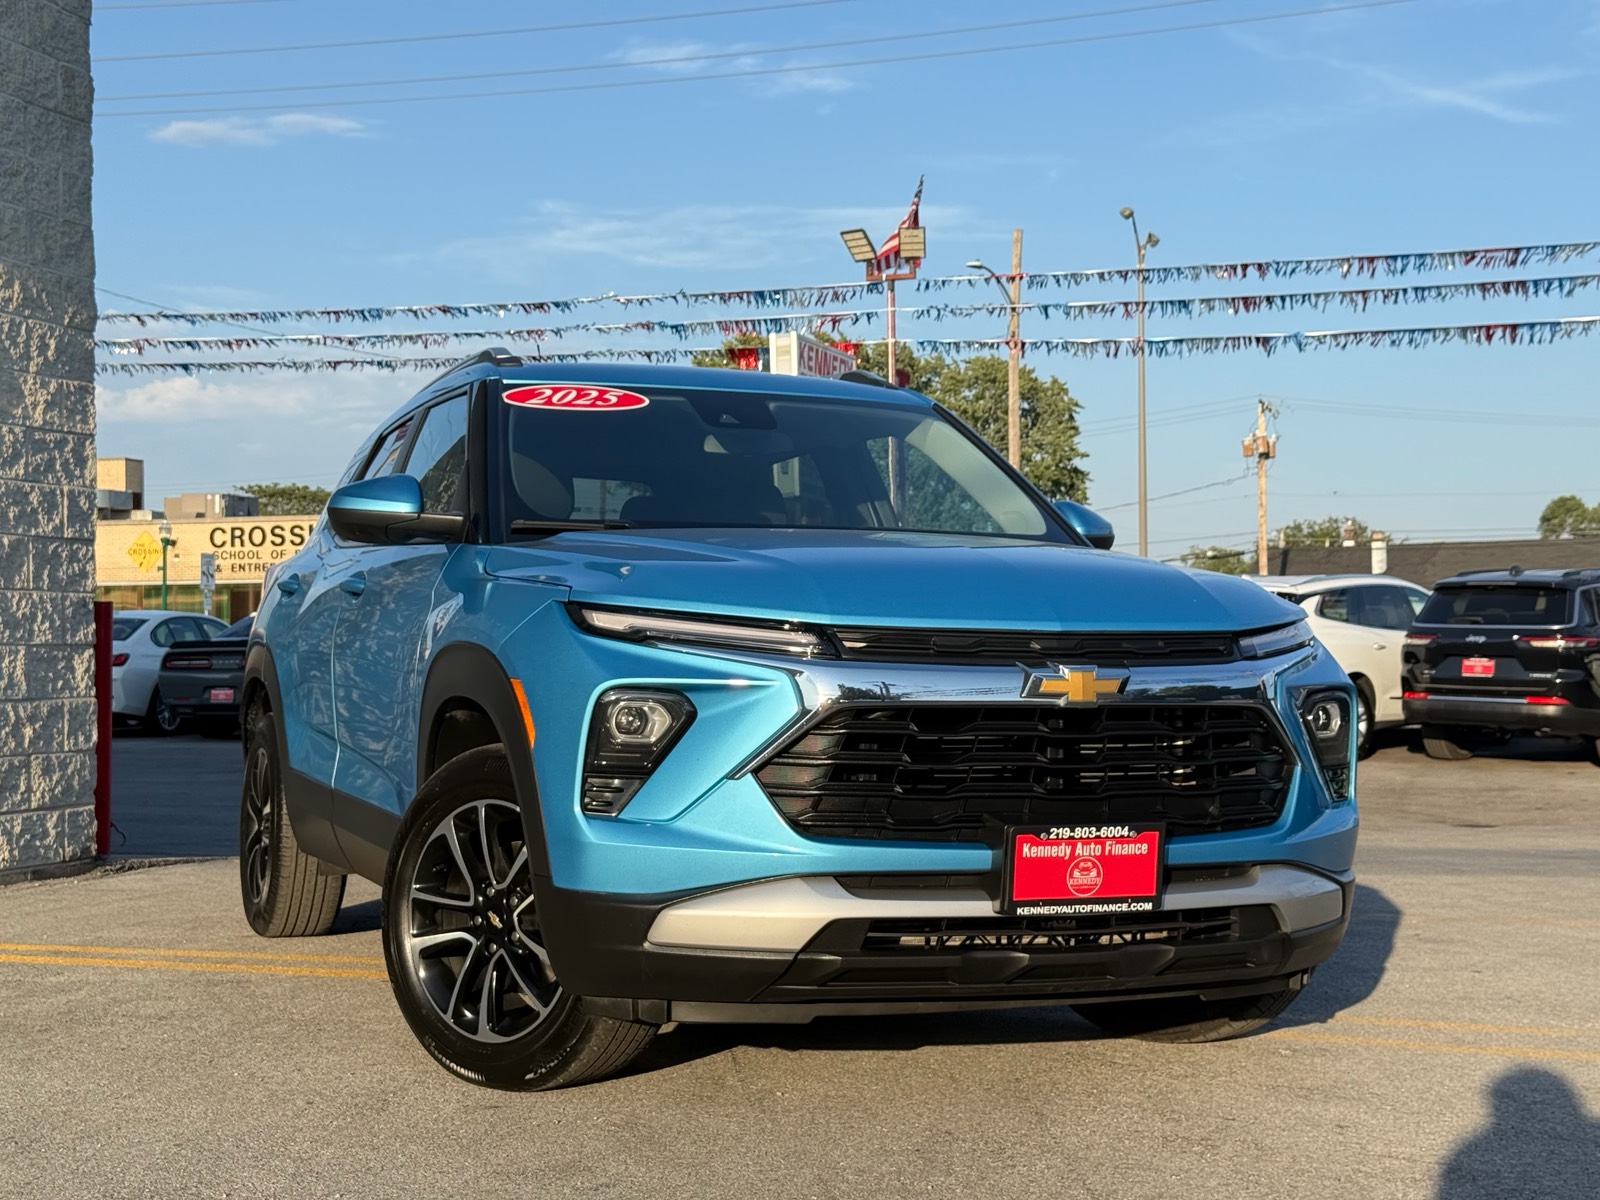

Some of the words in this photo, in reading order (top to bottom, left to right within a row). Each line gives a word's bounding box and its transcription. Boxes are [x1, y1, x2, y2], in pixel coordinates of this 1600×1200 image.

[525, 388, 624, 406] 2025
[213, 550, 262, 560] SCHOOL
[271, 549, 287, 560] OF
[215, 564, 222, 573] &
[1049, 826, 1129, 839] 219-803-6004
[1022, 842, 1072, 860] Kennedy
[1075, 841, 1102, 856] Auto
[1105, 840, 1149, 856] Finance
[1017, 902, 1153, 915] KENNEDYAUTOFINANCE.COM
